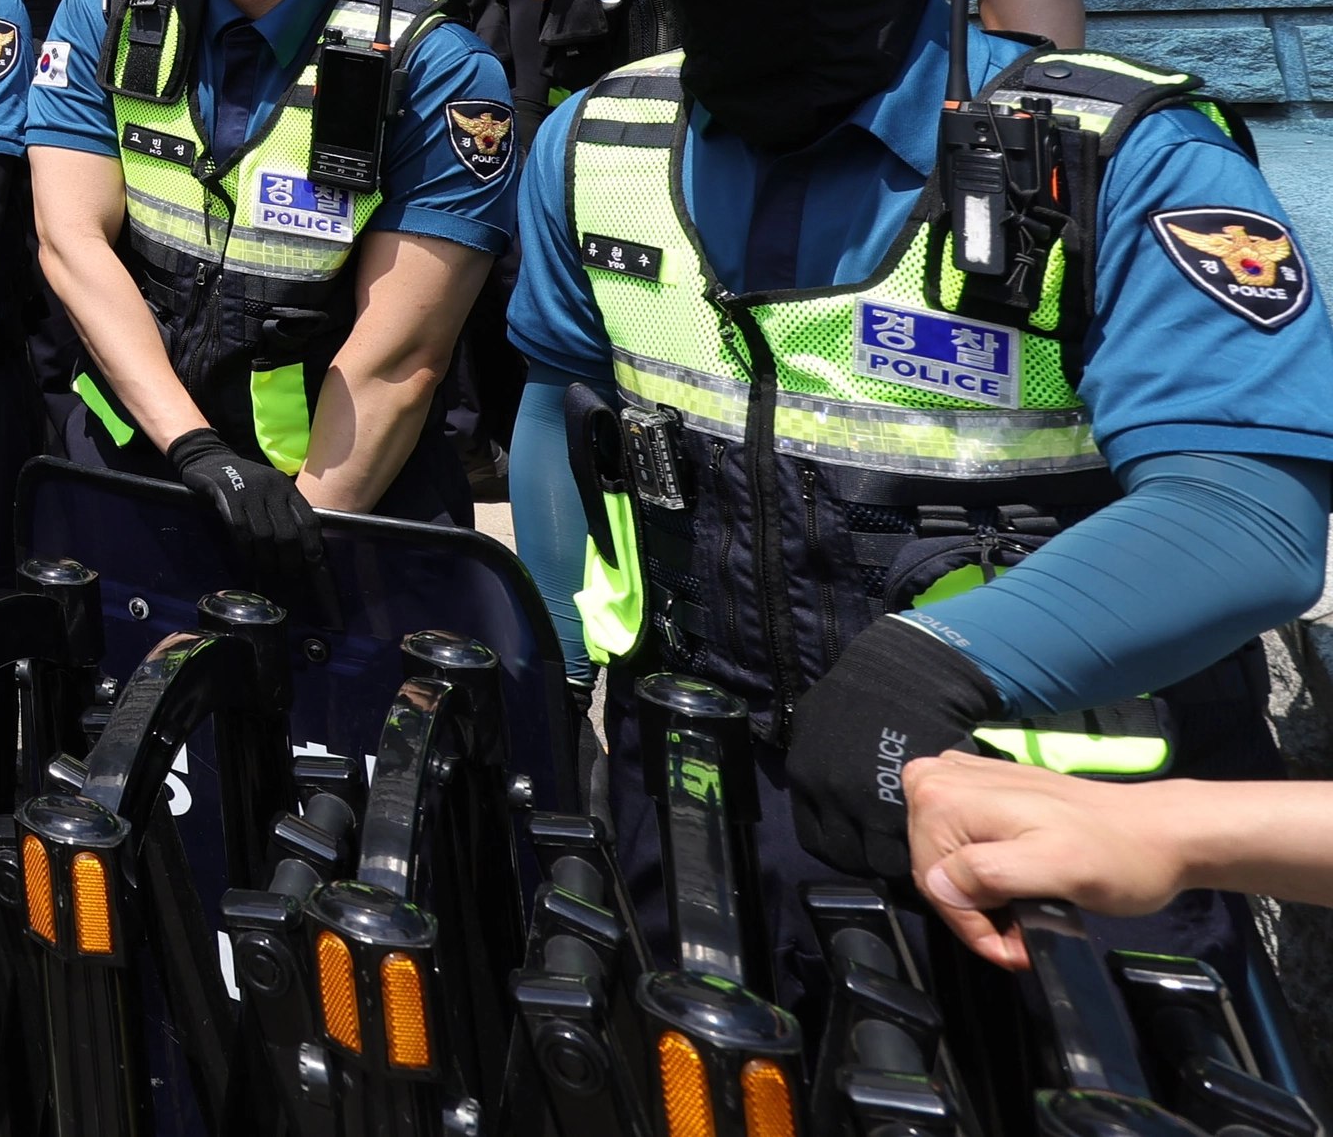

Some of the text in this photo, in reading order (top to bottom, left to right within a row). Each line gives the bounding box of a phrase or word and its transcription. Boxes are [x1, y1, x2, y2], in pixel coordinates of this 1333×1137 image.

[130, 132, 185, 156] 고민성
[149, 148, 162, 156] KO
[472, 154, 500, 164] POLICE
[266, 176, 343, 214] 경찰
[263, 210, 342, 233] POLICE
[588, 242, 650, 267] 유현수
[1228, 284, 1288, 299] POLICE
[871, 308, 1000, 370] 경찰
[870, 353, 1000, 397] POLICE
[221, 465, 245, 491] POLICE
[910, 612, 971, 648] POLICE
[876, 727, 908, 806] POLICE
